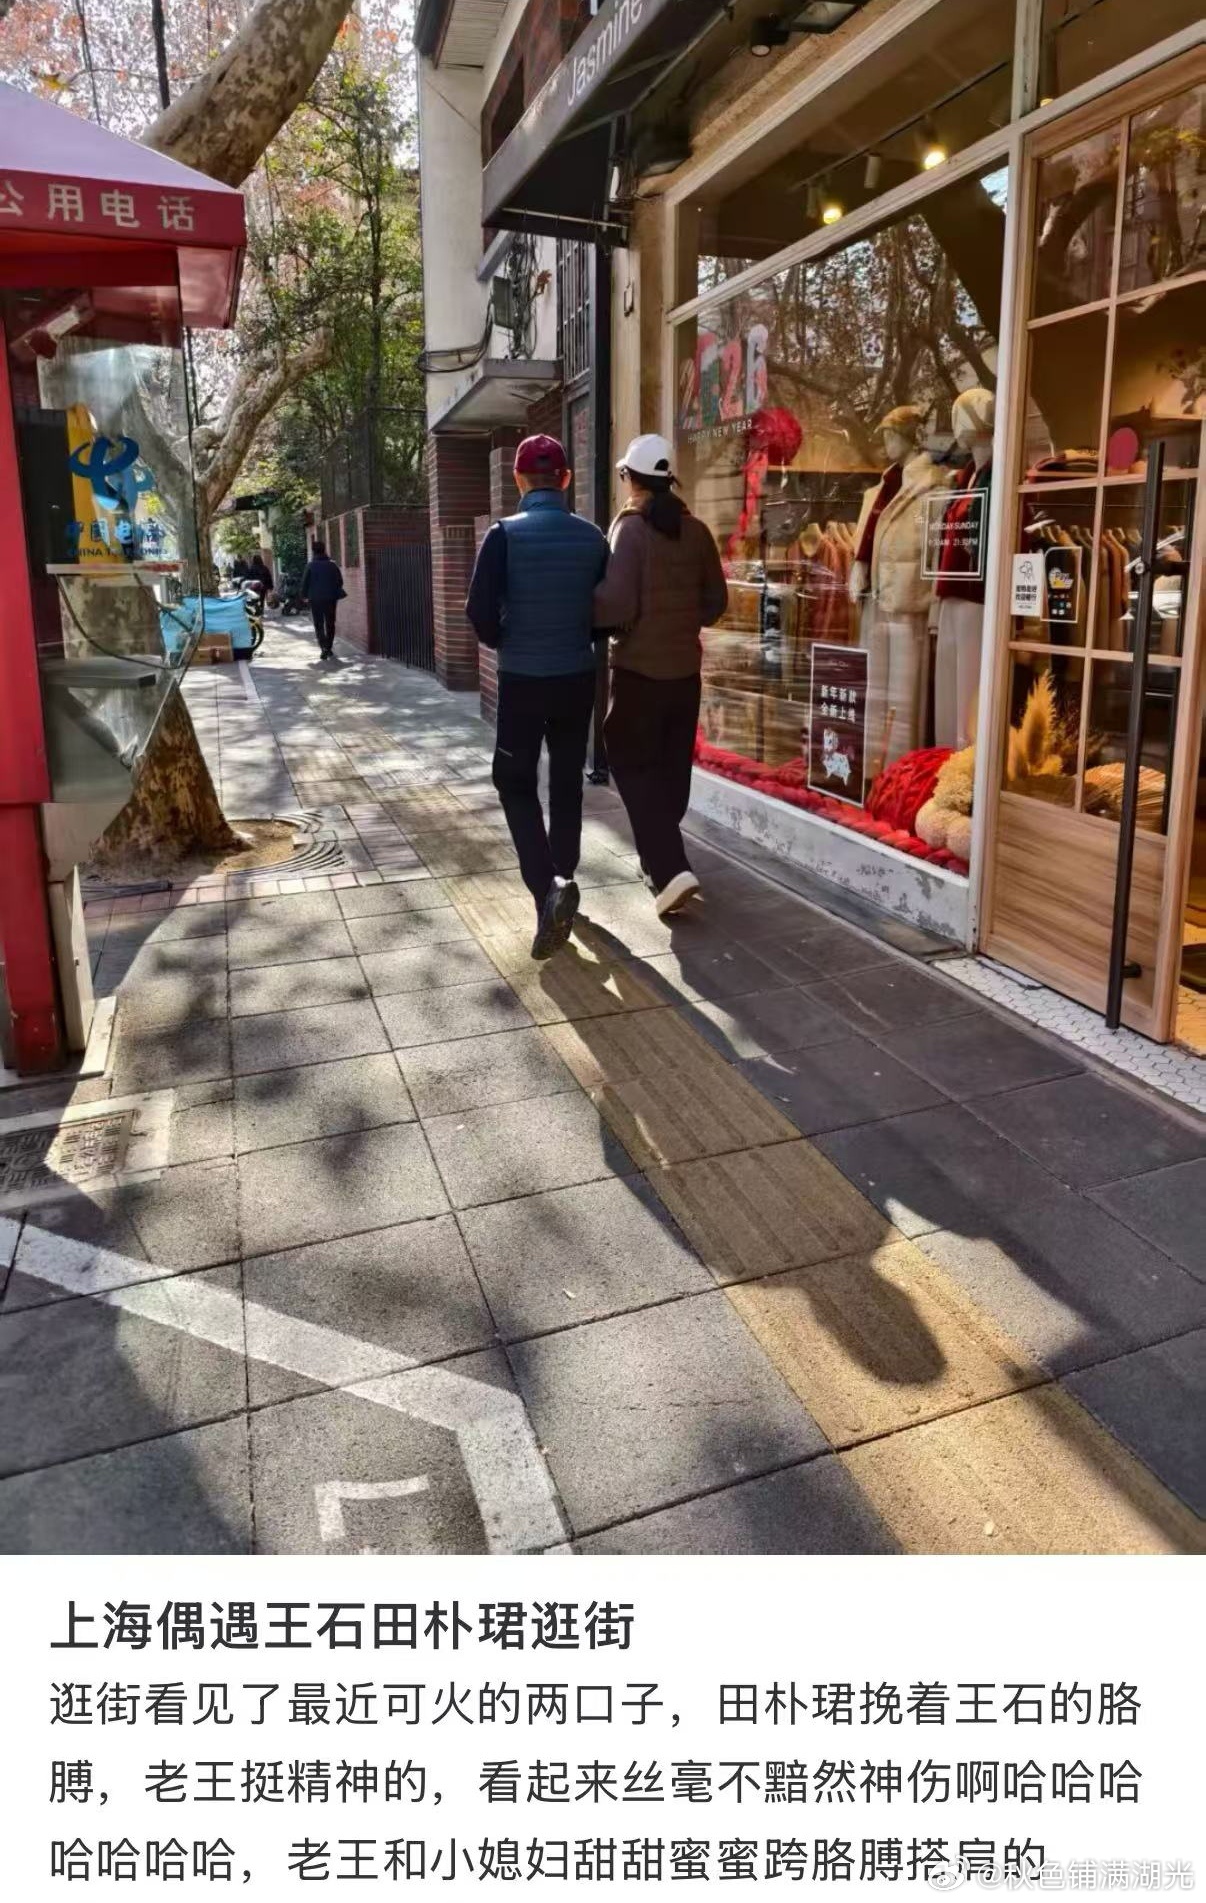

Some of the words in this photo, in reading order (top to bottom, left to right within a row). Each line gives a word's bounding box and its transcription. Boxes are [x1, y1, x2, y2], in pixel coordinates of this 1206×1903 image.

[568, 0, 642, 106] Jasmine
[0, 180, 195, 232] 公用电话
[731, 418, 753, 435] YEAR
